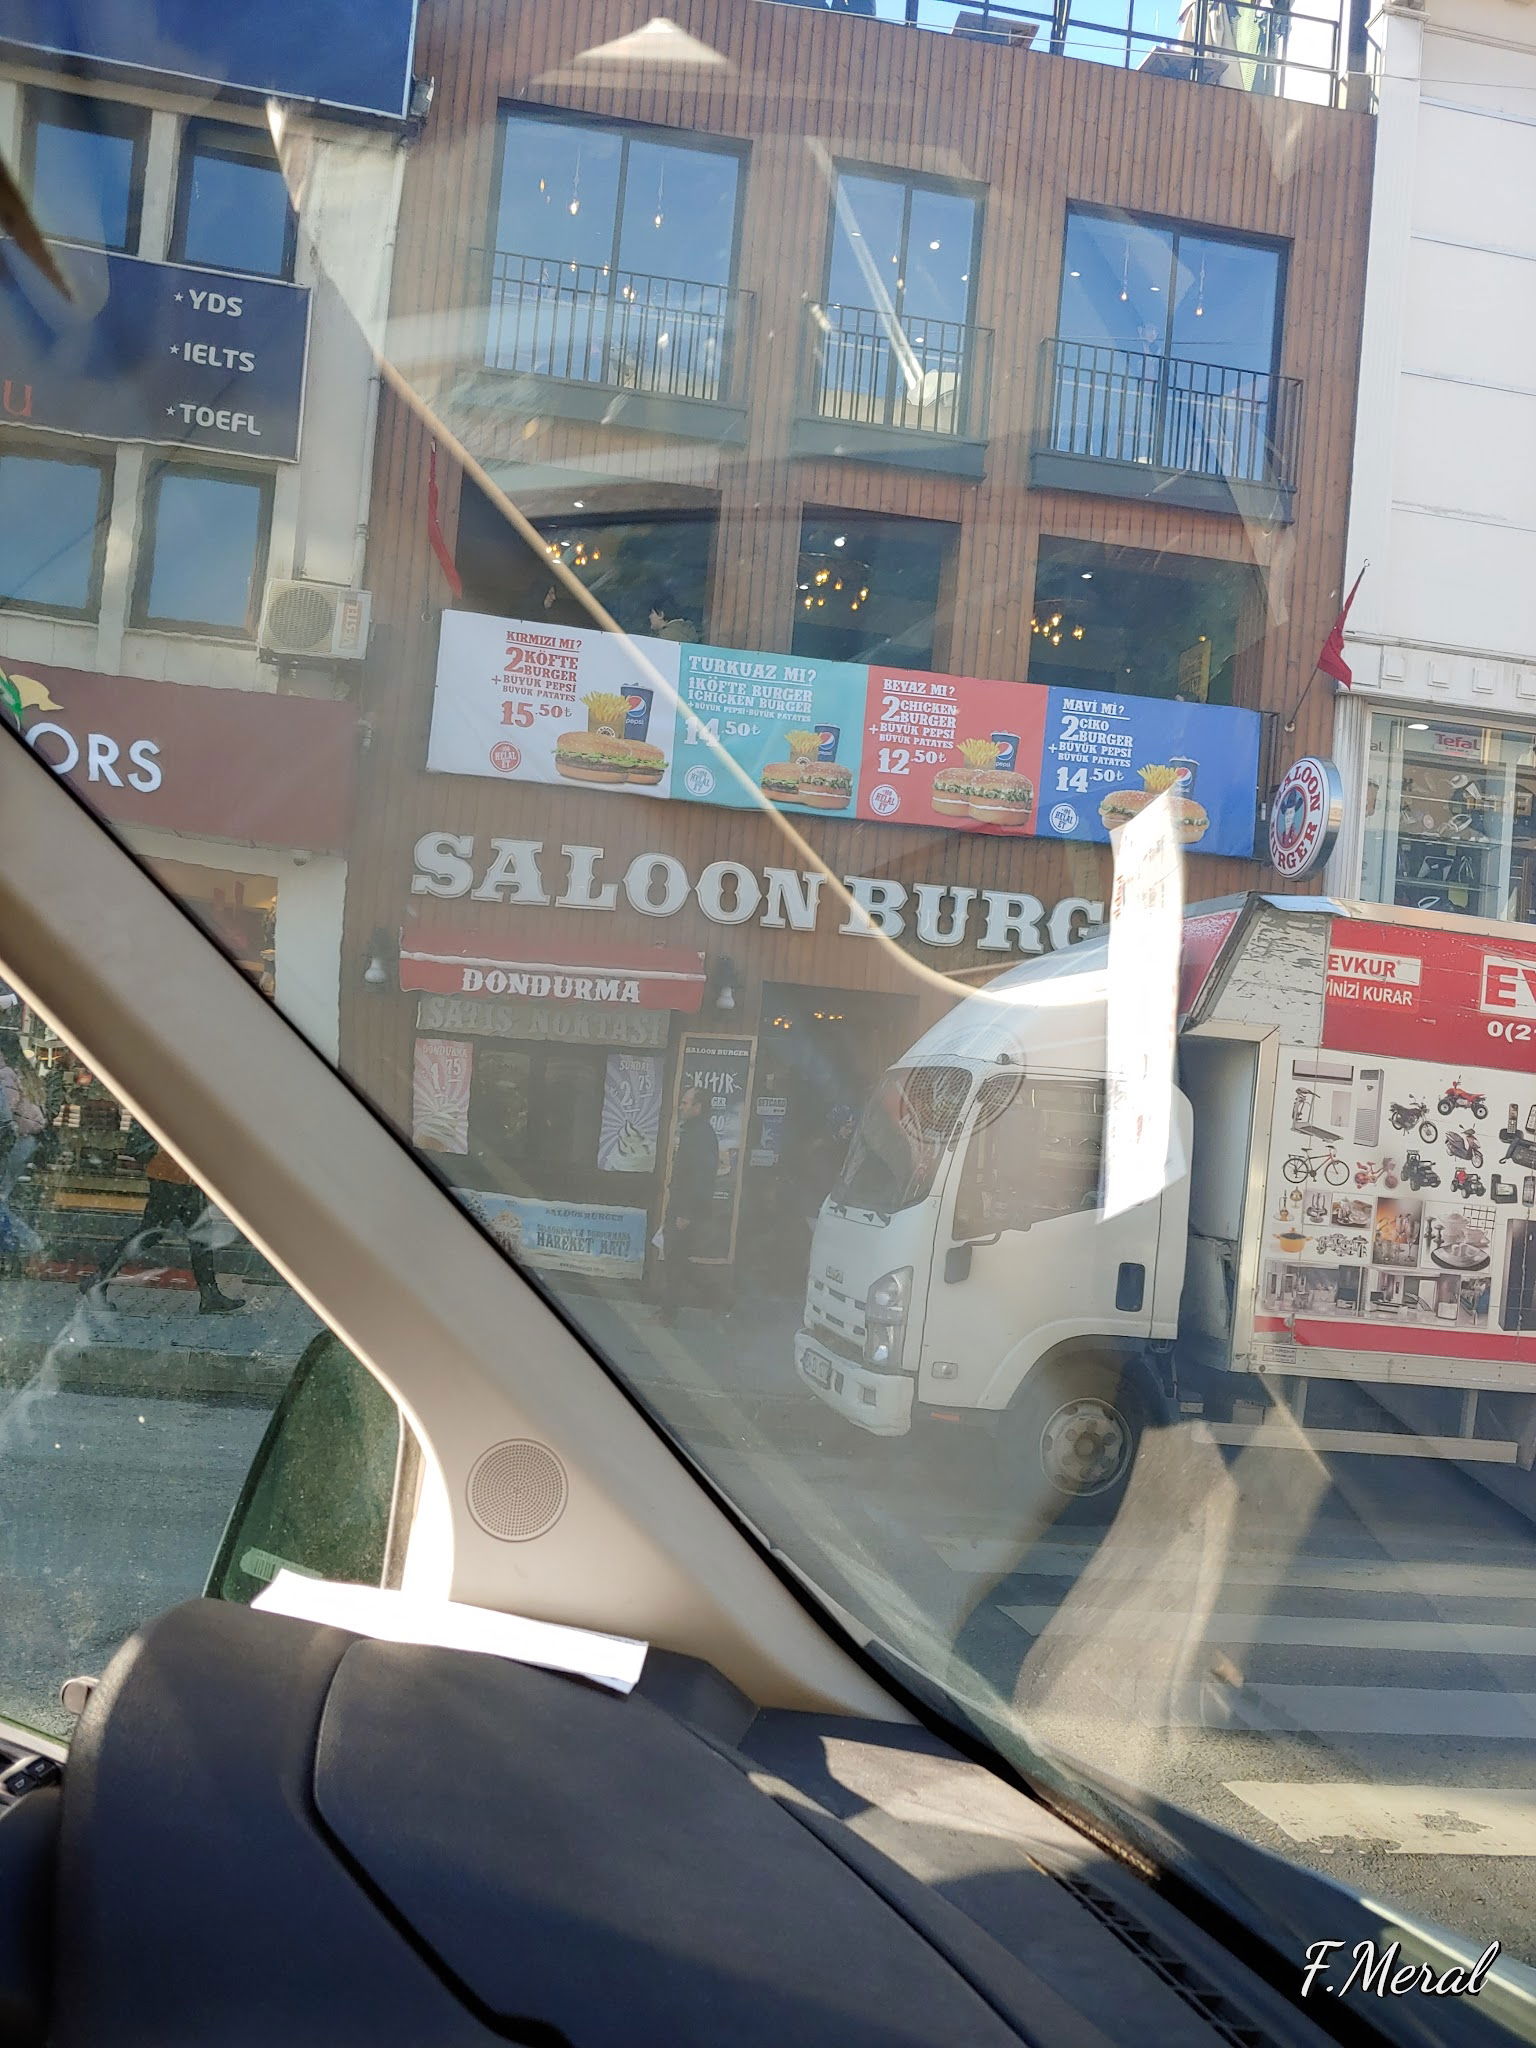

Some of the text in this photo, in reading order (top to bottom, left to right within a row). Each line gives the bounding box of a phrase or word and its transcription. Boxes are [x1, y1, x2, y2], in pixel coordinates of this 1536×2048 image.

[188, 289, 243, 317] YDS
[183, 342, 256, 373] IELTS
[179, 403, 262, 436] TOEFL
[506, 631, 557, 647] KIRMIZI
[524, 650, 579, 670] KÖFTE
[688, 655, 817, 683] TURKUAZ MI?
[523, 664, 577, 683] BURGER
[503, 673, 541, 688] BÜYÜK
[545, 680, 577, 693] PEPSİ
[882, 678, 927, 694] BEYAZ
[536, 690, 576, 702] PATATES
[751, 684, 813, 703] BURGER
[758, 697, 813, 714] BURGER
[900, 699, 958, 716] CHICKEN
[1062, 698, 1098, 713] MAVİ
[879, 722, 919, 736] BÜYÜK
[900, 711, 957, 729] BURGER
[879, 733, 955, 749] BÜYÜK PATATES
[1079, 730, 1134, 748] BURGER
[1434, 733, 1481, 751] Tefal
[1058, 741, 1098, 754] BÜYÜK
[1101, 745, 1132, 758] PEPSİ
[1058, 752, 1131, 768] BÜYÜK PATATES
[410, 831, 828, 932] SALOON
[1327, 953, 1396, 978] EVKUR
[461, 967, 641, 1003] DONDURMA
[1362, 985, 1413, 1006] KURAR
[685, 1047, 750, 1057] SALOON BURGER
[536, 1231, 595, 1254] HAREKET
